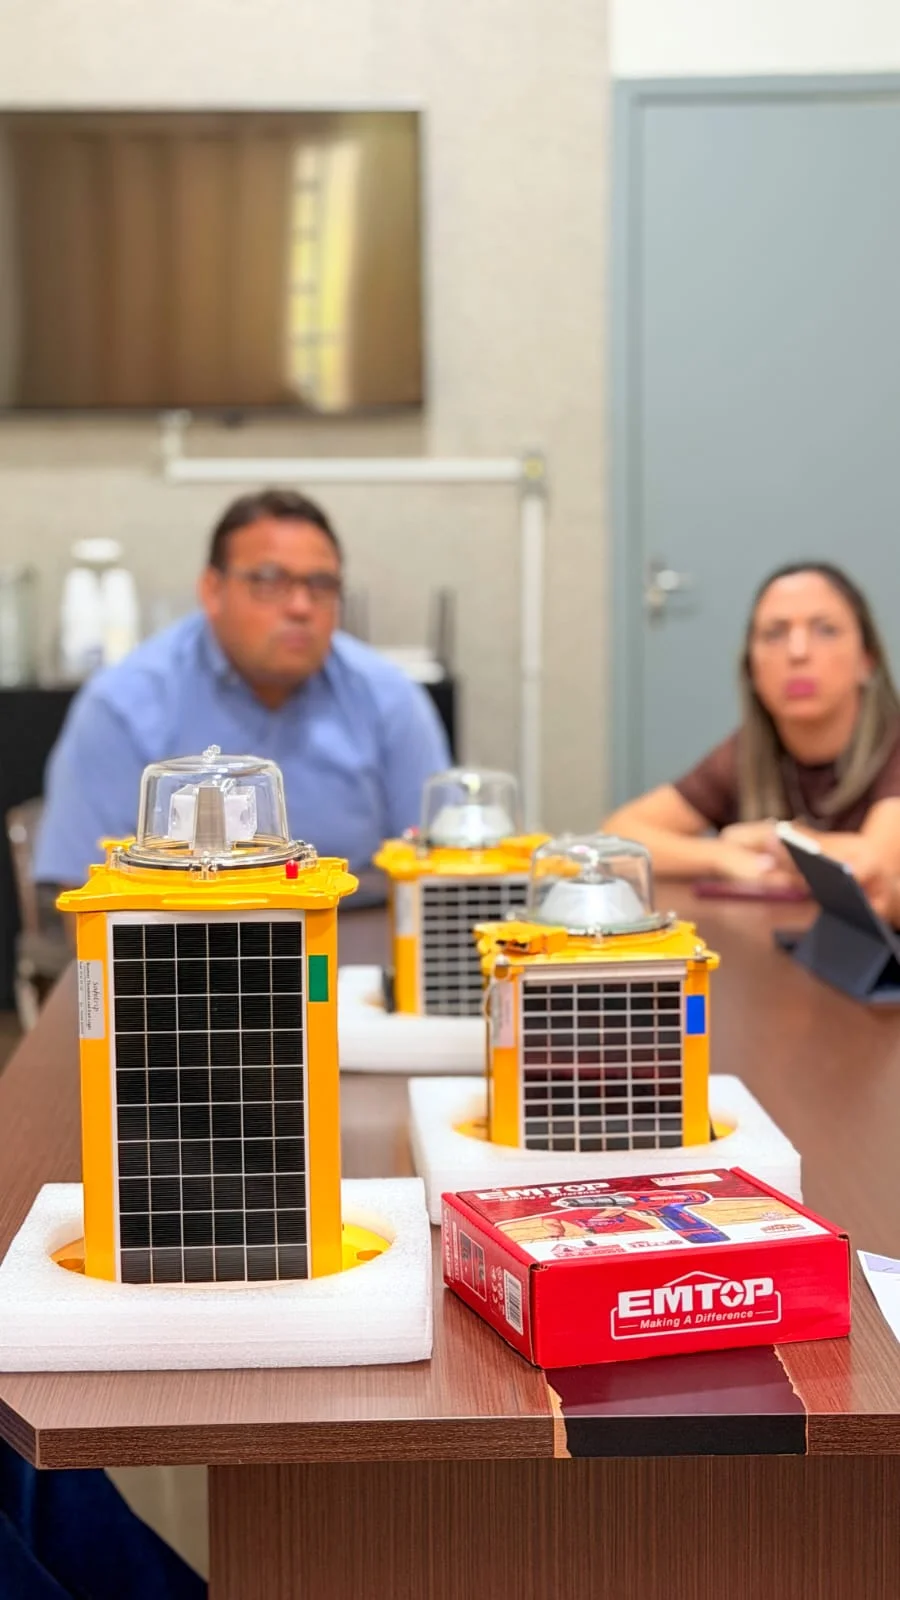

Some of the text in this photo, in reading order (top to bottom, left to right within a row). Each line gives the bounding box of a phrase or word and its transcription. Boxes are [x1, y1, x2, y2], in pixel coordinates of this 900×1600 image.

[475, 1182, 610, 1200] EMTOP
[618, 1277, 774, 1319] EMTOP
[640, 1310, 754, 1329] Making A Difference
